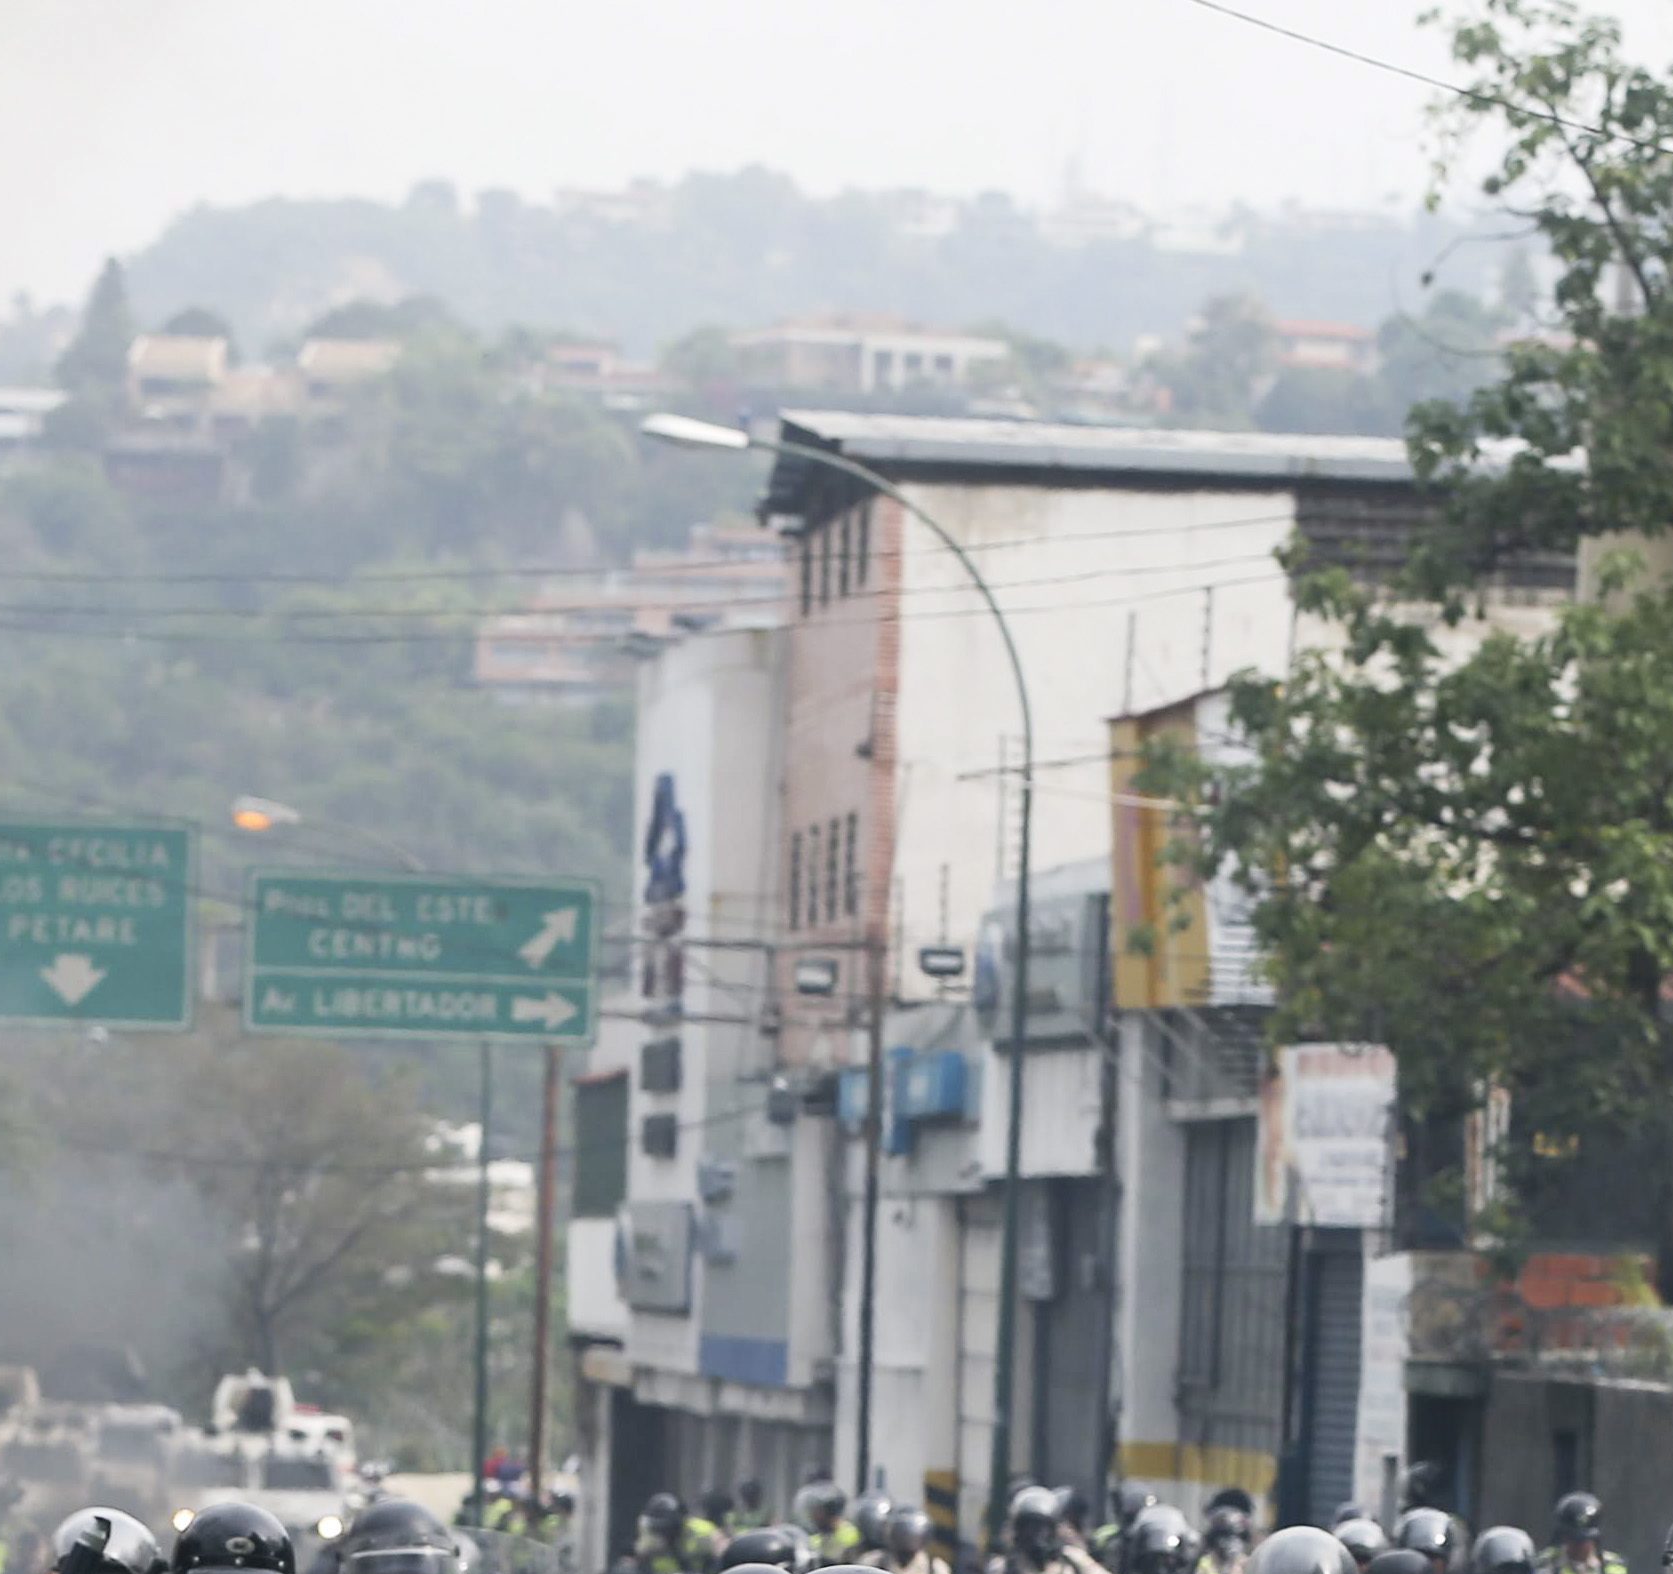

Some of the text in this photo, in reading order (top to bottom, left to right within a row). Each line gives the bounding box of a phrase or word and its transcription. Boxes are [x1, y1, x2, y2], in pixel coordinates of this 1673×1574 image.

[341, 891, 397, 923] DEL
[414, 894, 494, 926] ESTE
[7, 913, 138, 946] PETARE
[311, 985, 500, 1021] LIBERTADOR
